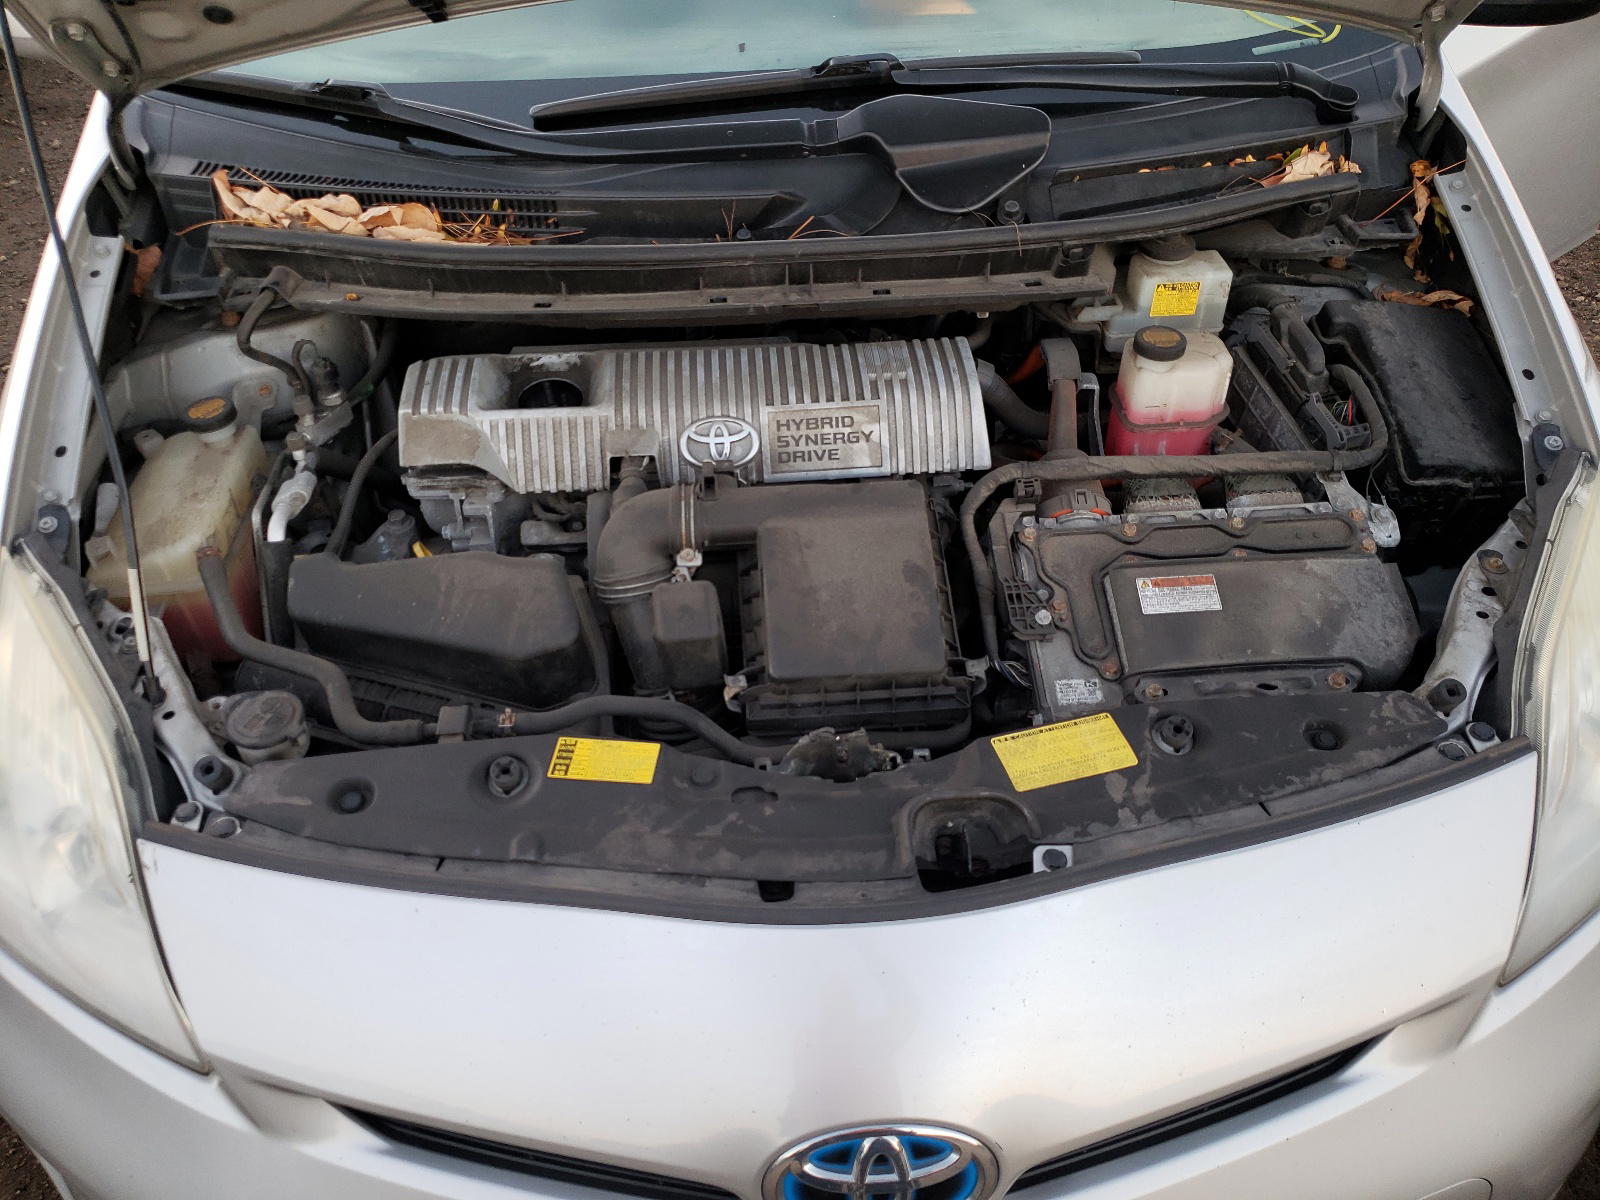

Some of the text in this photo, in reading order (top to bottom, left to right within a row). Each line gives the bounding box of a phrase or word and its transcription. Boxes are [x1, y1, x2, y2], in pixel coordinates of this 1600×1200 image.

[776, 415, 854, 432] HYBRID
[776, 430, 874, 448] SYNERGY
[777, 448, 840, 464] DRIVE
